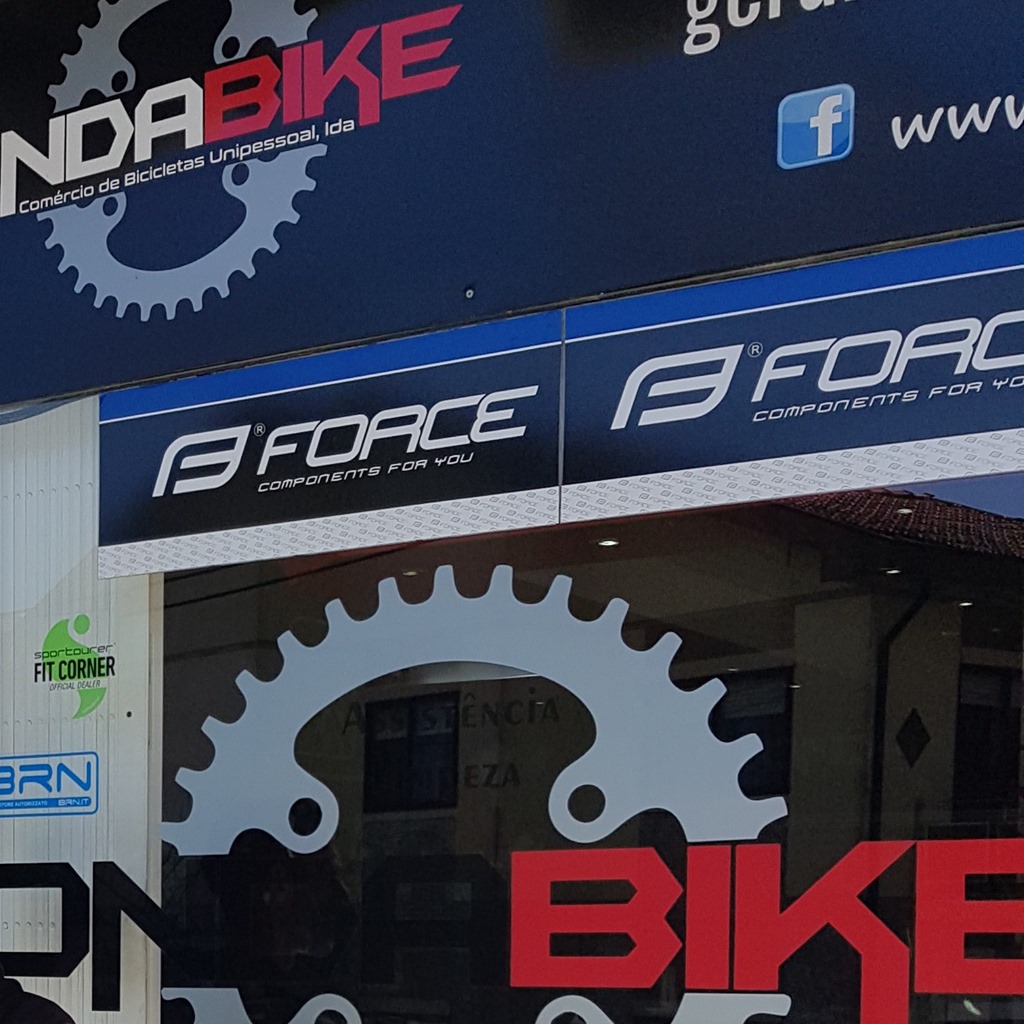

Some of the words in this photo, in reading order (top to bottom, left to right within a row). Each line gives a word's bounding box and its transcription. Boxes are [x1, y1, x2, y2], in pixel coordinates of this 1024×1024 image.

[19, 184, 95, 214] Comércio
[98, 177, 120, 193] de
[124, 154, 205, 187] Bicicletas
[209, 123, 321, 163] Unipessoal,
[752, 390, 919, 422] COMPONENTS
[928, 381, 983, 399] FOR
[256, 385, 539, 476] FORCE
[257, 466, 382, 494] COMPONENTS
[388, 459, 428, 475] FOR
[434, 452, 476, 467] YOU
[34, 643, 114, 660] sportourer
[34, 661, 54, 683] FIT
[58, 655, 116, 680] CORNER
[49, 681, 76, 691] OFFICIAL
[77, 680, 101, 689] DEALER
